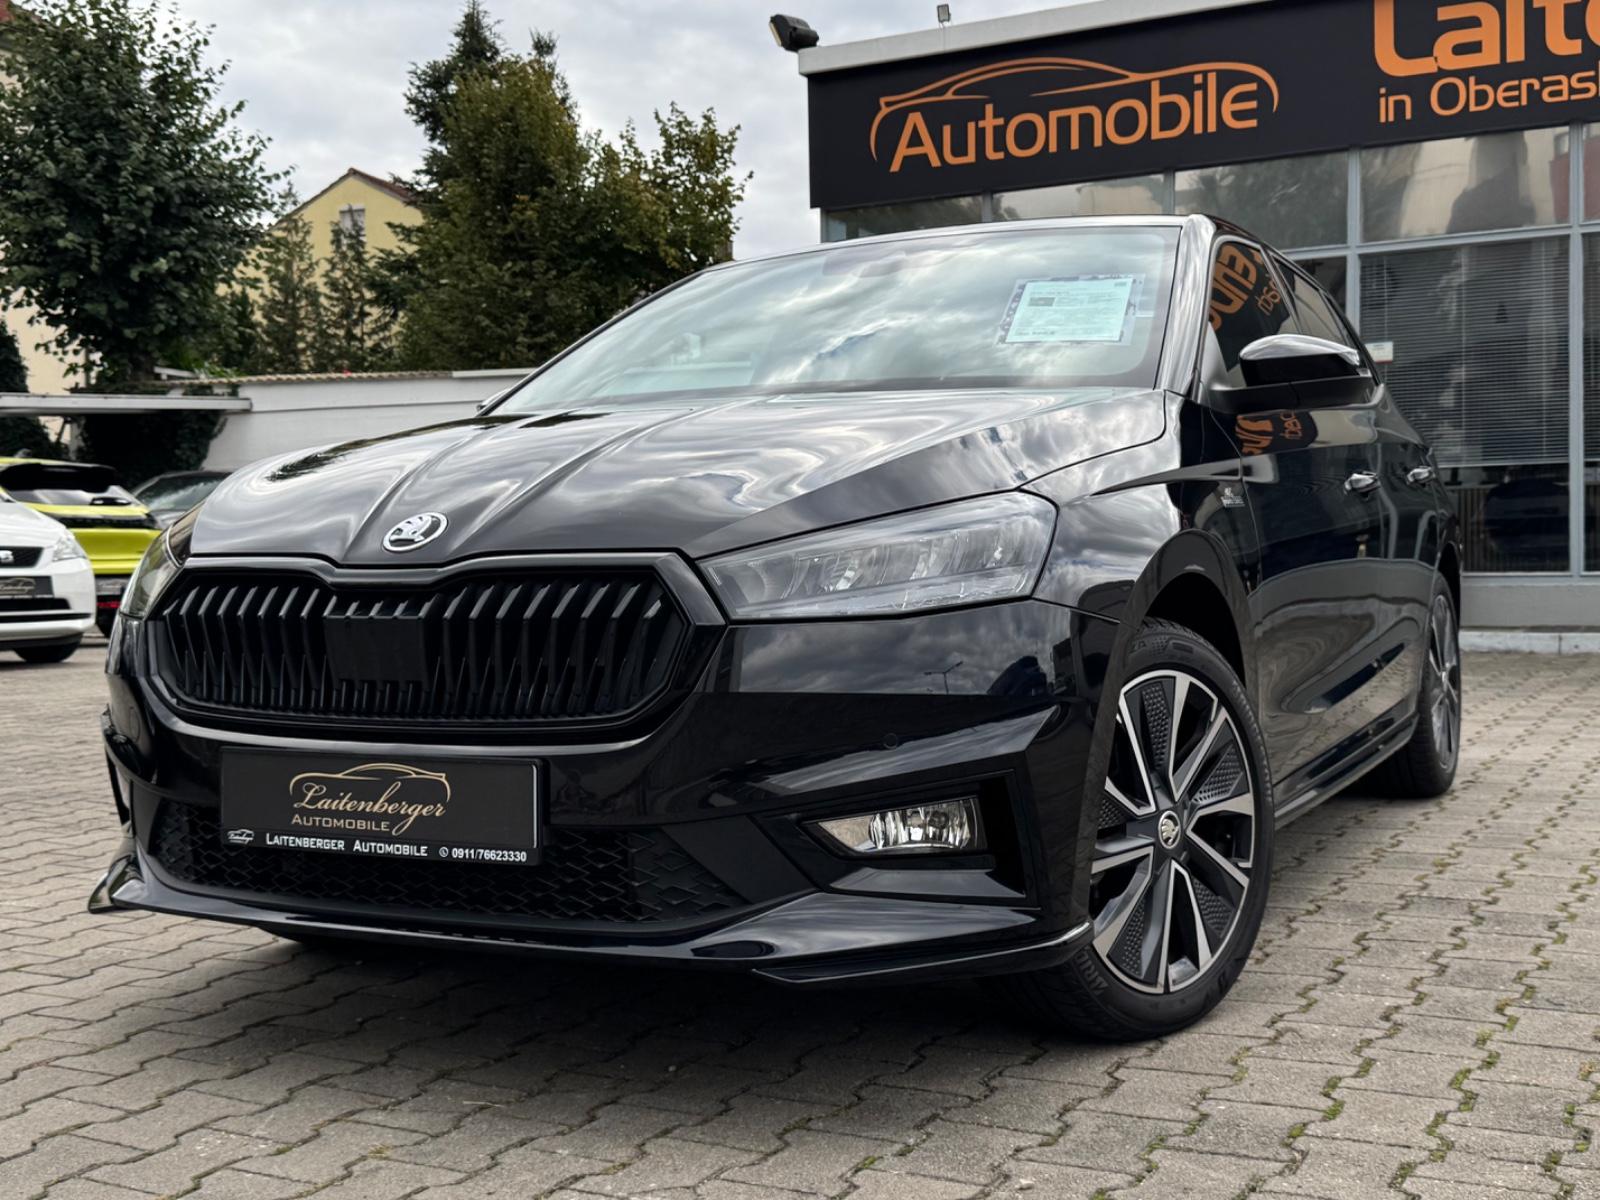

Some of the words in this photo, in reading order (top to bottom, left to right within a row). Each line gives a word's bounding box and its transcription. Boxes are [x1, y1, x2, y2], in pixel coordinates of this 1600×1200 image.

[1379, 87, 1412, 123] in
[1430, 62, 1600, 116] Oberas
[889, 71, 1258, 173] Automobile
[291, 813, 390, 832] AUTOMOBILE
[293, 781, 446, 836] Laitenberger
[266, 833, 345, 850] LAITENBERGER
[353, 839, 428, 857] AUTOMOBILE
[451, 847, 527, 862] 0911/76623330
